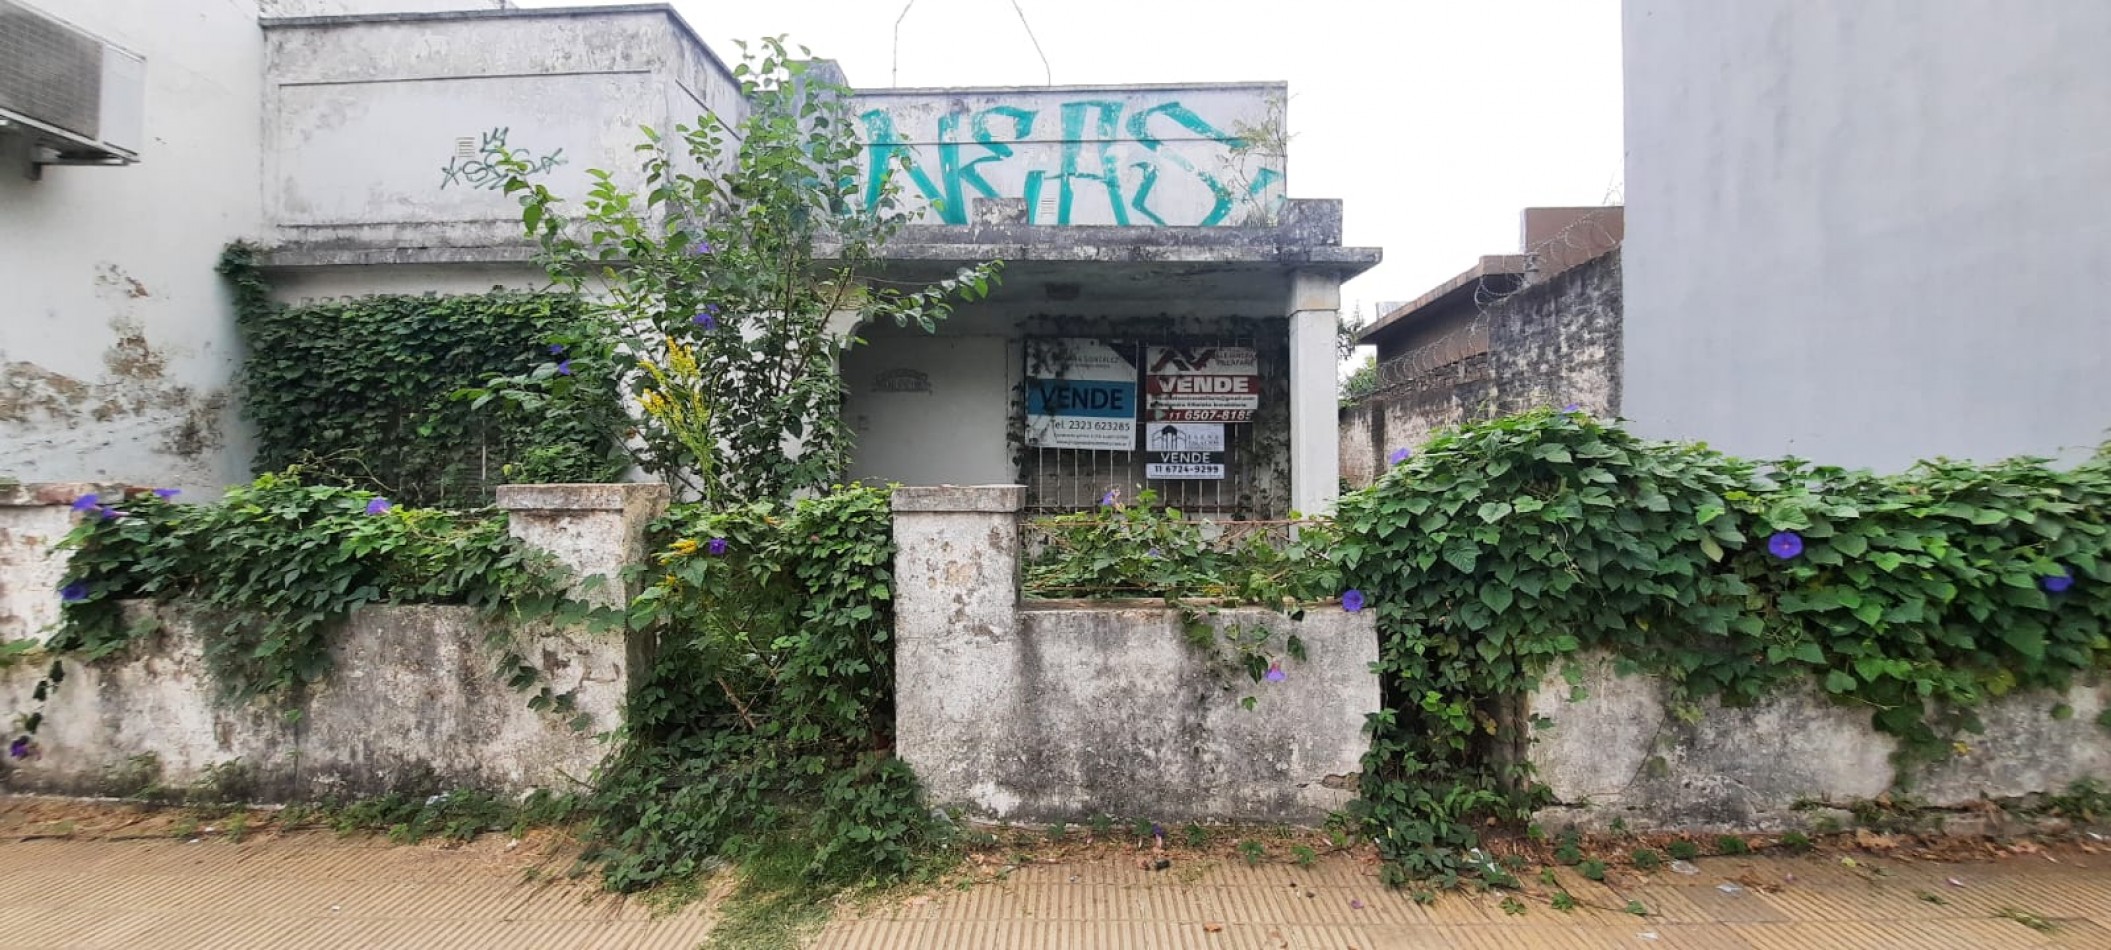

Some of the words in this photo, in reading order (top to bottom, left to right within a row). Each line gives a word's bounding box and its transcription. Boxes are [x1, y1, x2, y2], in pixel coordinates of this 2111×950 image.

[1159, 376, 1249, 393] VENDE
[1040, 387, 1123, 410] VENDE
[1069, 420, 1092, 430] 2323
[1094, 421, 1130, 431] 623285
[1160, 452, 1211, 463] VENDE
[1155, 465, 1162, 473] 11
[1165, 465, 1219, 473] 6724-9299
